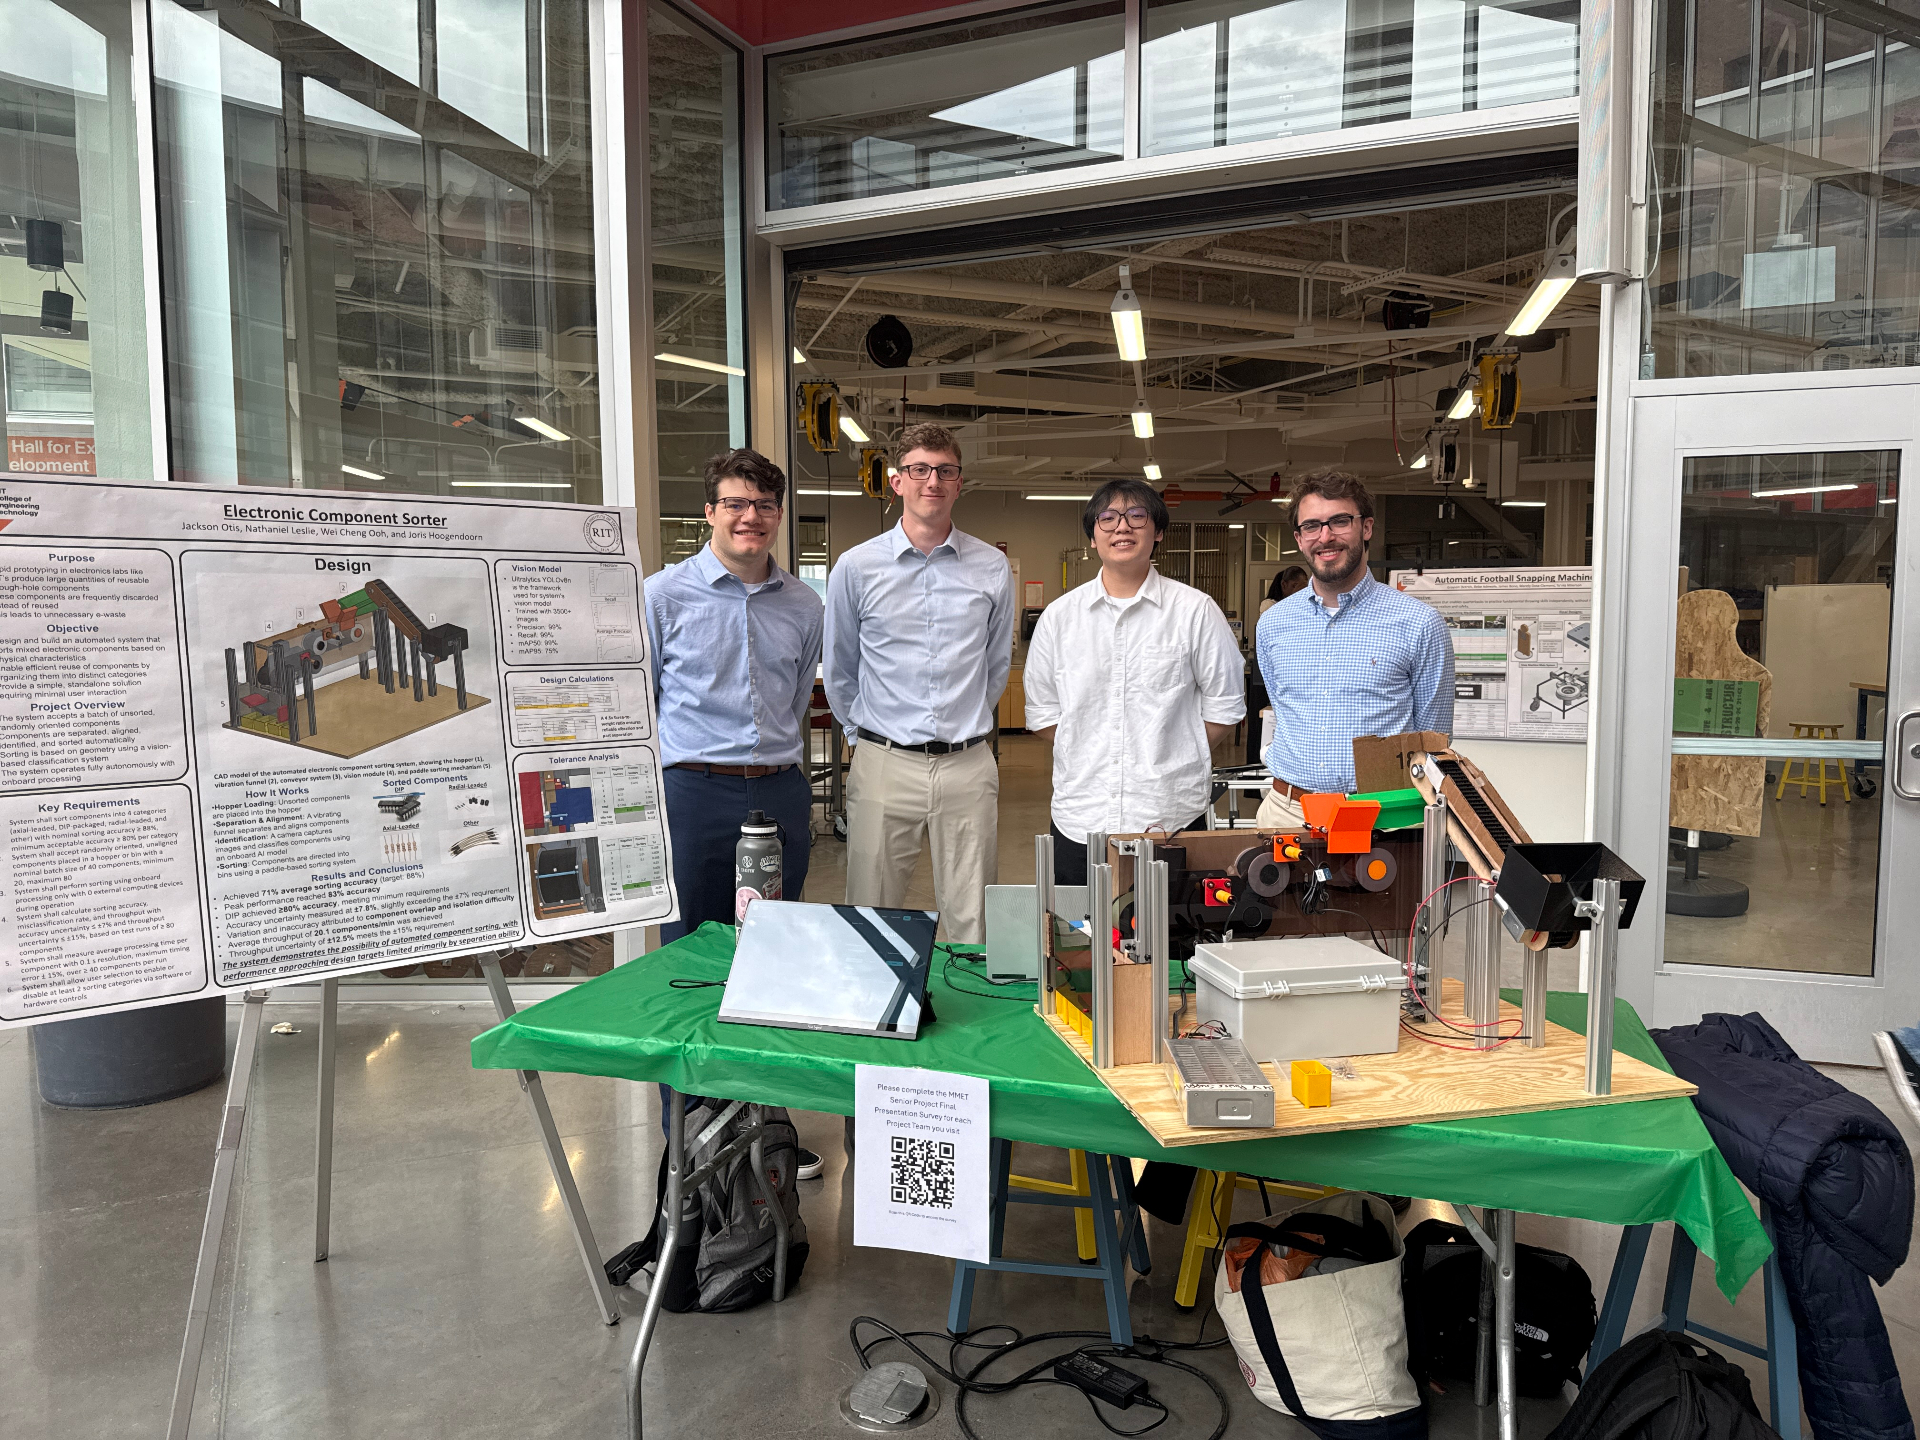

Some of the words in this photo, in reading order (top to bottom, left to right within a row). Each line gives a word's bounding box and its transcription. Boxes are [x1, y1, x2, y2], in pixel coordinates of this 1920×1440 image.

[12, 440, 43, 453] Hall
[47, 441, 71, 454] for
[75, 441, 95, 454] Ex
[9, 458, 89, 472] elopment
[223, 505, 304, 520] Electronic
[308, 508, 398, 524] Component
[402, 512, 447, 526] Sorter
[182, 522, 218, 530] Jackson
[221, 524, 242, 532] Otis,
[245, 525, 288, 533] Nathaniel
[291, 527, 318, 535] Leslie,
[340, 528, 366, 538] Cheng
[429, 532, 482, 541] Hoogendoorn
[592, 528, 612, 537] RIT
[49, 554, 94, 563] Purpose
[315, 558, 370, 574] Design
[1479, 574, 1513, 582] Football
[1516, 574, 1555, 583] Snapping
[46, 624, 98, 634] Objective
[30, 702, 70, 712] Project
[74, 701, 124, 709] Overview
[383, 778, 411, 786] Sorted
[414, 775, 467, 784] Components
[278, 787, 308, 795] Works
[38, 804, 59, 812] Key
[64, 798, 140, 810] Requirements
[311, 872, 346, 881] Results
[349, 869, 365, 877] and
[368, 864, 423, 875] Conclusions
[223, 891, 259, 900] Achieved
[241, 908, 276, 918] achieved
[302, 901, 339, 910] accuracy,
[406, 886, 449, 896] requirements
[246, 897, 294, 908] performance
[296, 892, 326, 901] reached
[346, 887, 380, 895] accuracy
[226, 920, 261, 929] Accuracy
[264, 914, 305, 924] uncertainty
[308, 908, 343, 918] measured
[380, 901, 404, 909] slightly
[406, 897, 440, 905] exceeding
[472, 887, 509, 896] requirement
[226, 930, 260, 938] Variation
[279, 922, 319, 931] inaccuracy
[321, 916, 354, 926] attributed
[365, 909, 407, 920] component
[239, 957, 266, 967] system
[269, 949, 324, 961] demonstrates
[340, 940, 379, 953] possibility
[381, 938, 388, 946] of
[391, 932, 430, 944] automated
[433, 926, 472, 938] component
[474, 923, 500, 932] sorting,
[502, 920, 517, 928] with
[222, 967, 275, 981] performance
[277, 959, 326, 972] approaching
[329, 955, 354, 964] design
[357, 950, 383, 960] targets
[386, 945, 410, 955] limited
[413, 941, 445, 952] primarily
[458, 934, 495, 945] separation
[498, 930, 518, 939] ability
[948, 1091, 968, 1099] MMET
[913, 1099, 938, 1107] Project
[939, 1102, 956, 1110] Final
[874, 1107, 917, 1116] Presentation
[919, 1111, 942, 1121] Survey
[886, 1120, 910, 1128] Project
